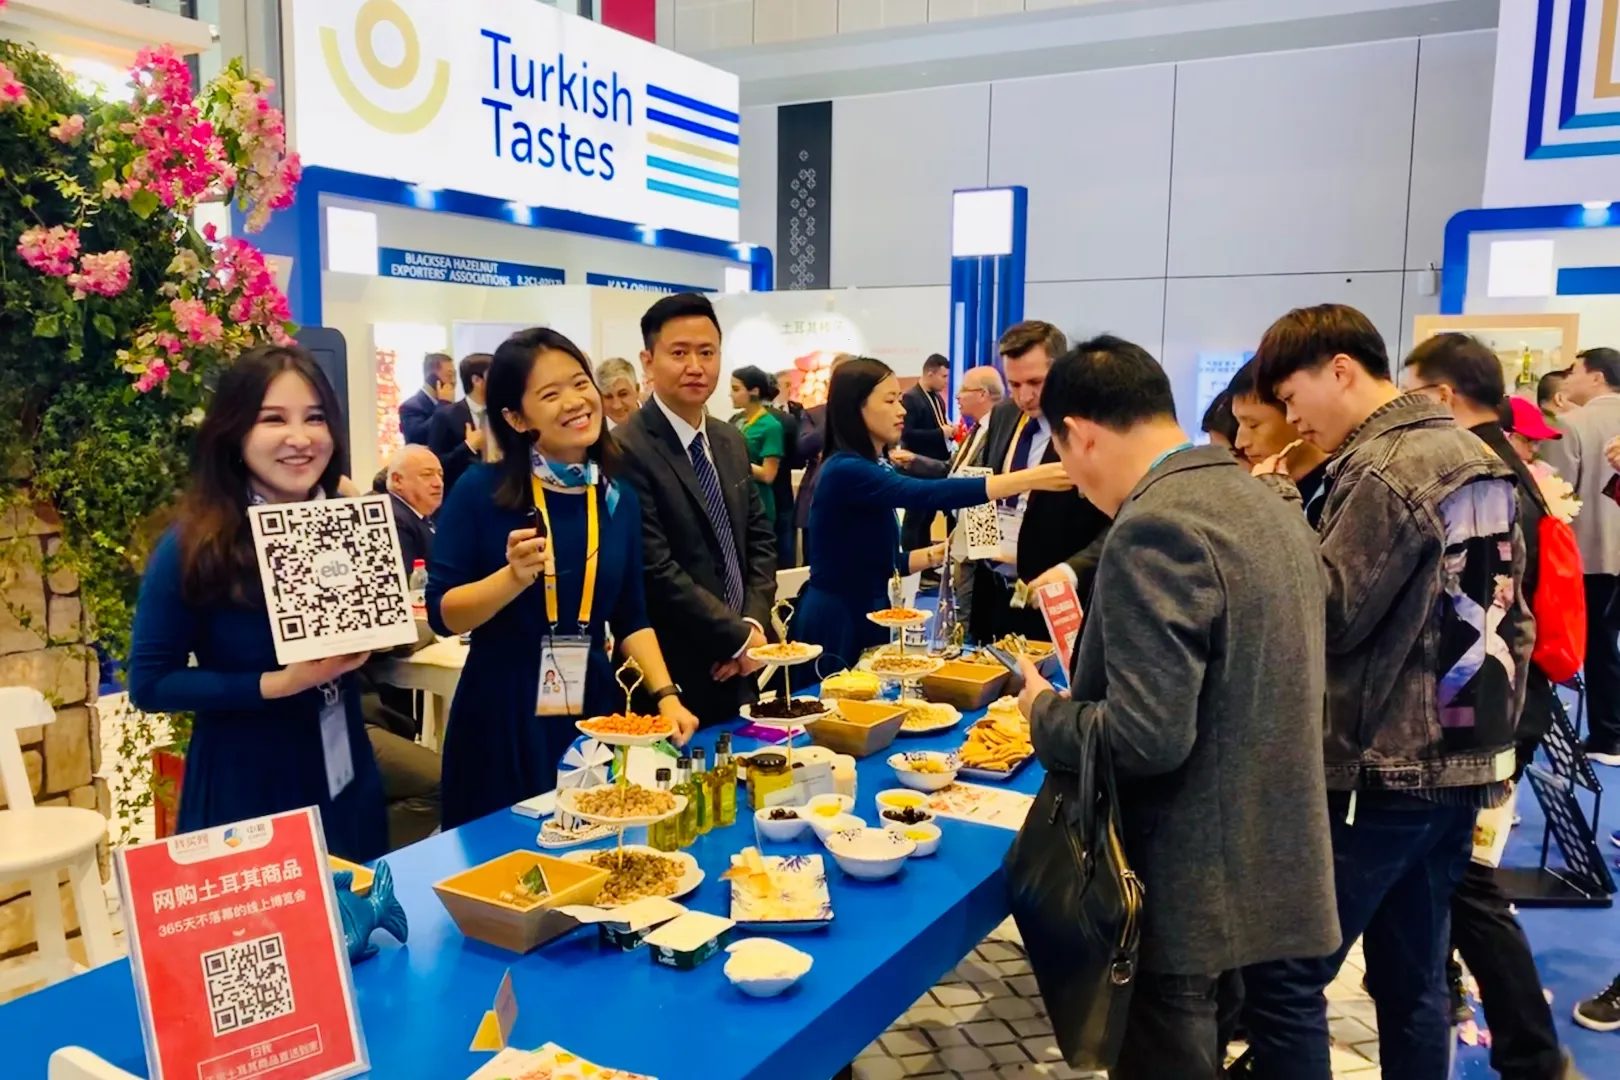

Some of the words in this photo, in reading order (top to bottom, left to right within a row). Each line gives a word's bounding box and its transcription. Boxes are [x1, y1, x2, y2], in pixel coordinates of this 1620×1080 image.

[481, 28, 632, 126] Turkish
[481, 97, 615, 181] Tastes
[391, 264, 448, 280] EXPORTERS'
[449, 270, 511, 287] ASSOCIATIONS
[405, 253, 452, 268] BLACKSEA
[453, 257, 499, 274] HAZELNUT
[320, 560, 349, 578] eib
[152, 858, 303, 914] 网购土耳其商品
[158, 889, 307, 938] 365天不落幕的线上博览会
